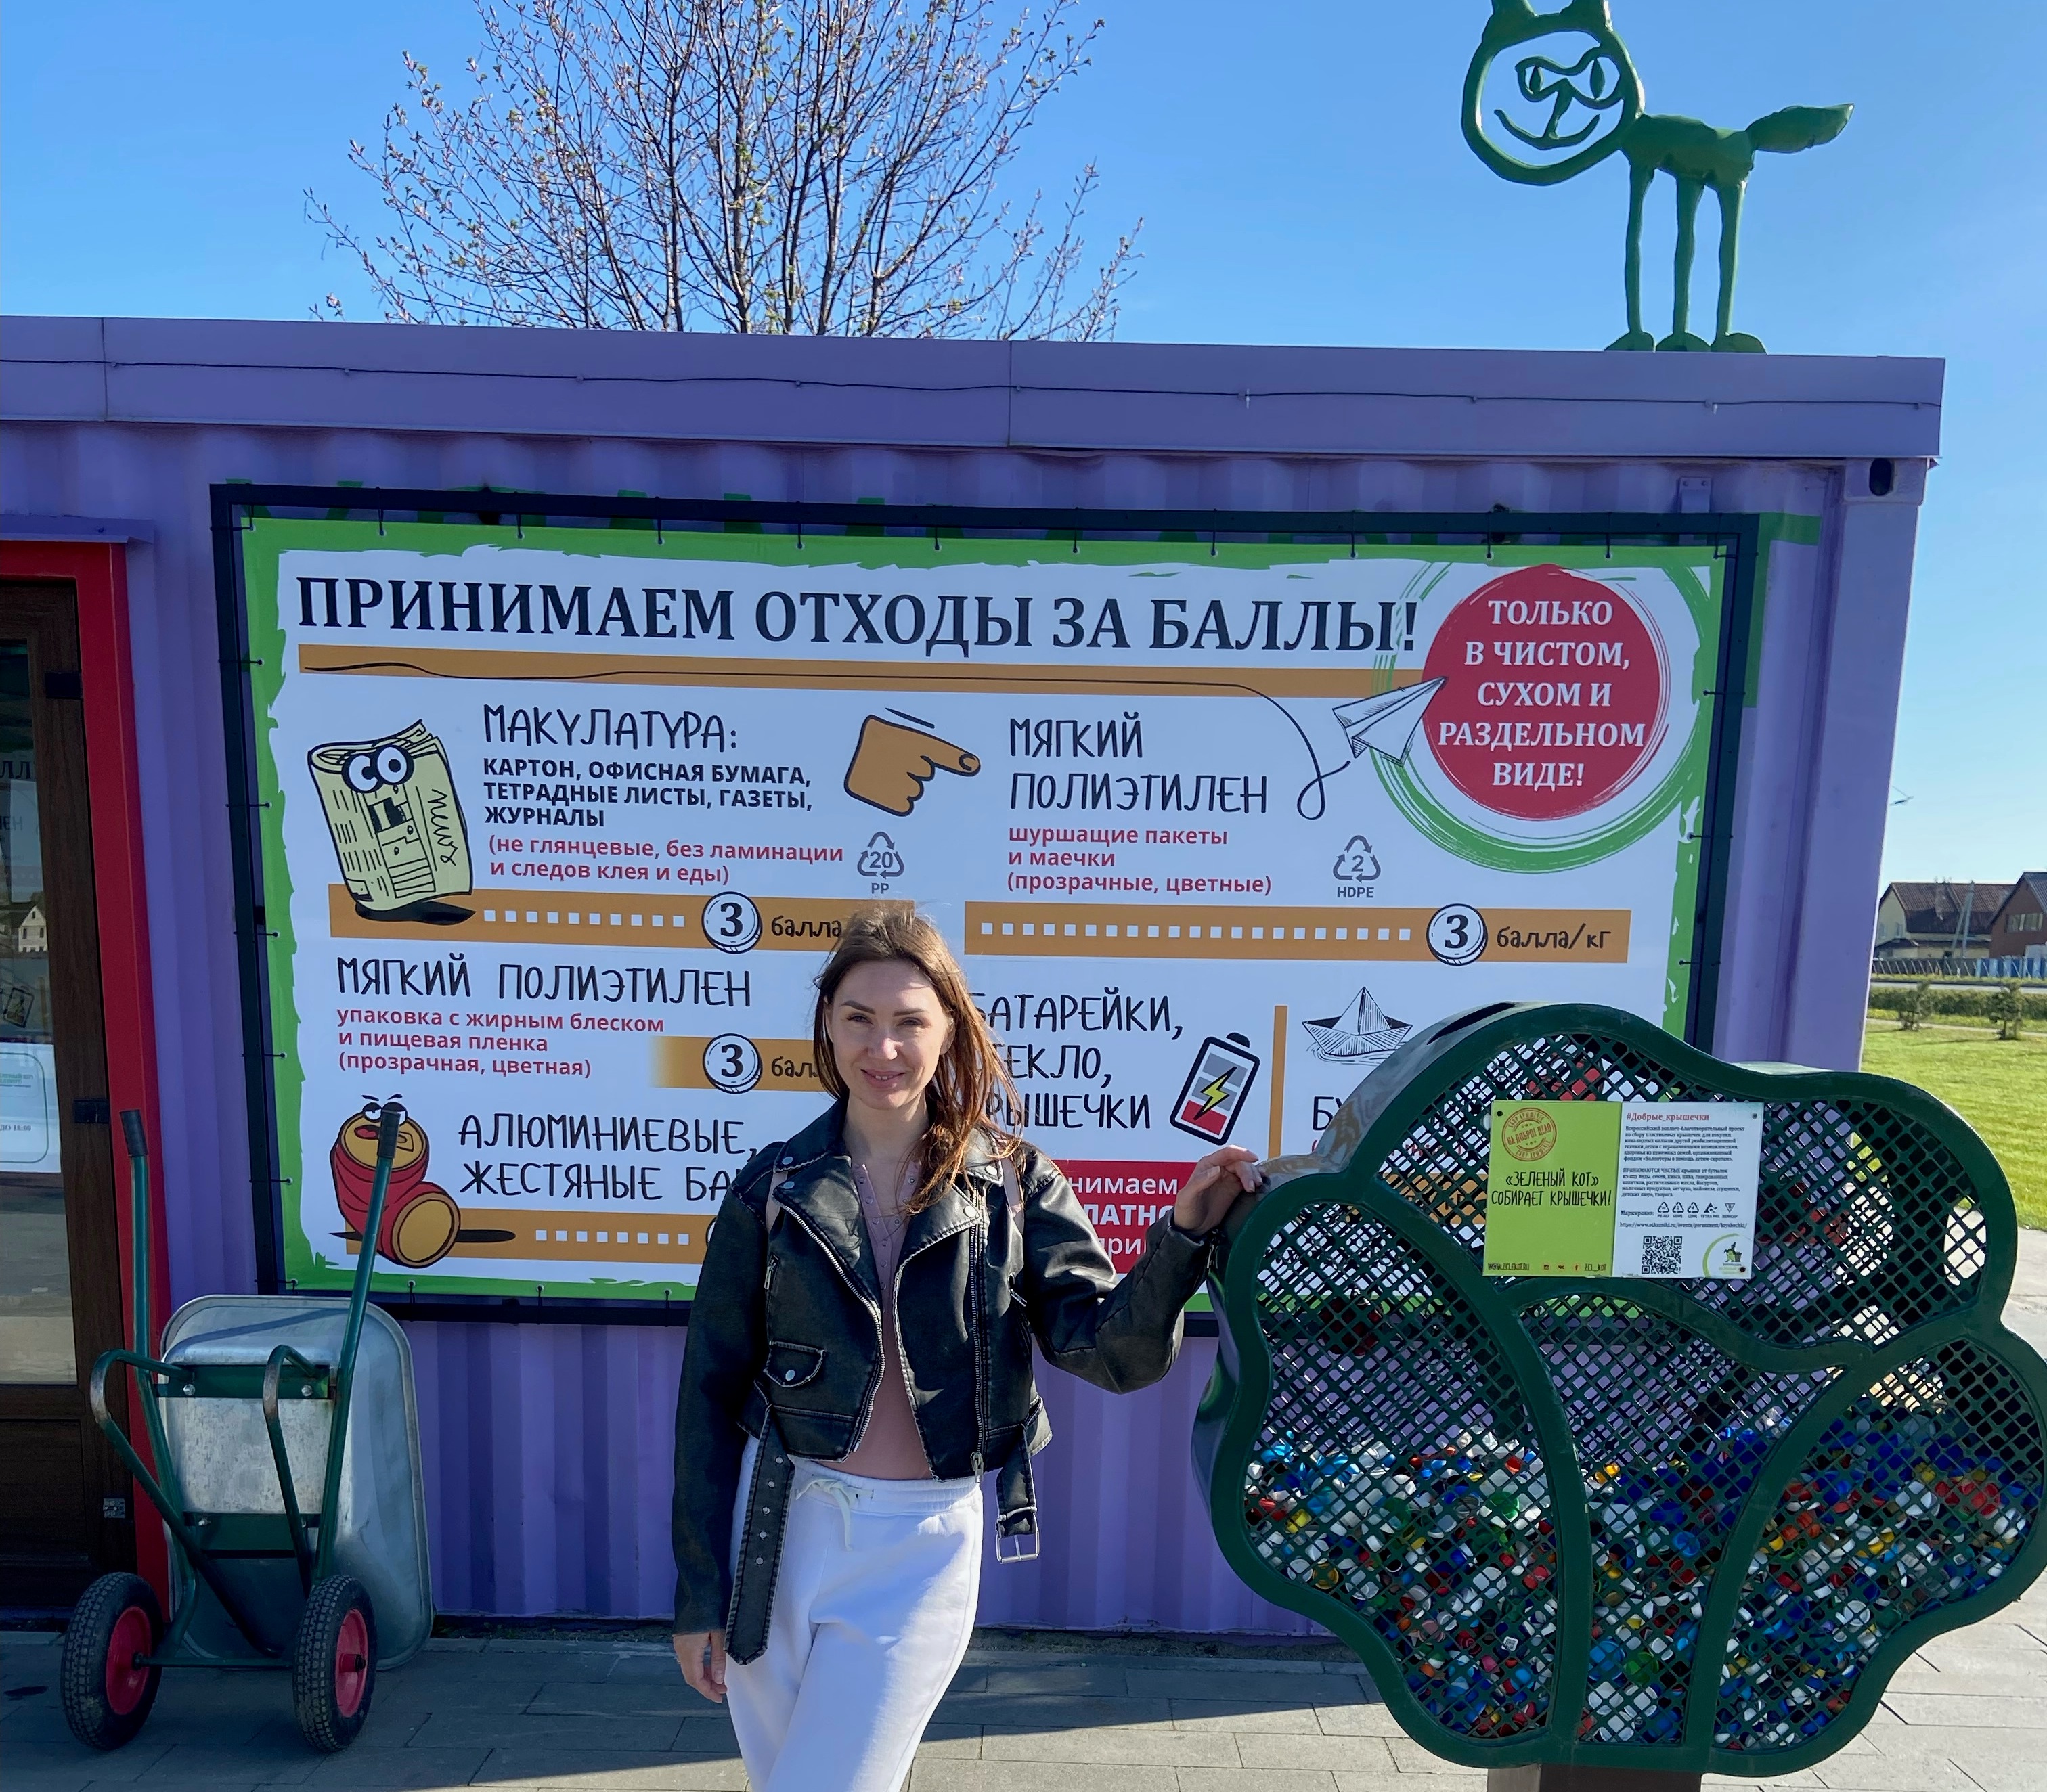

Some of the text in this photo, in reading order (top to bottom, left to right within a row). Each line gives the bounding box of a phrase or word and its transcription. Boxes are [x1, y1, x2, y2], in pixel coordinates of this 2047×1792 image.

[296, 577, 1417, 658] ПРИНИМАЕМ ОТХОДЫ ЗА БАЛЛЫ!
[1489, 601, 1612, 625] ТОЛЬКО
[1464, 642, 1629, 669] В ЧИСТОМ,
[1478, 682, 1612, 706] СУХОМ И
[484, 704, 736, 752] МАКУЛАТУРА:
[1011, 712, 1143, 757] МЯГКИЙ
[1439, 723, 1644, 751] РАЗДЕЛЬНОМ
[484, 758, 810, 787] КАРТОН, ОФИСНАЯ БУМАГА,
[1493, 763, 1583, 791] ВИДЕ!
[484, 782, 812, 811] ТЕТРАДНЫЕ ЛИСТЫ, ГАЗЕТЫ,
[1011, 773, 1267, 813] ПОЛИЭТИЛЕН
[485, 807, 604, 826] ЖУРНАЛЫ
[489, 835, 842, 864] (не глянцевые, без ламинации
[1010, 828, 1227, 847] шуршащие пакеты
[870, 851, 897, 868] 20
[1009, 852, 1114, 866] и маечки
[1352, 855, 1363, 872] 2
[491, 862, 728, 885] и следов клея и еды)
[1008, 872, 1271, 895] (прозрачные, цветные)
[872, 883, 889, 894] PP
[1338, 887, 1374, 897] HDPE
[720, 903, 743, 937] 3
[1445, 915, 1611, 949] 3 балла/кг
[338, 953, 750, 1006] МЯГКИЙ ПОЛИЭТИЛЕН
[337, 1010, 663, 1032] упаковка с жирным блеском
[339, 1033, 547, 1051] и пищевая пленка
[340, 1052, 590, 1078] (прозрачная, цветная)
[722, 1044, 743, 1077] 3
[1627, 1113, 1709, 1121] #Добрые_крышечки
[458, 1113, 761, 1159] АЛЮМИНИЕВЫЕ,
[1515, 1127, 1537, 1144] ДОБРОЕ
[460, 1161, 663, 1200] ЖЕСТЯНЫЕ
[1506, 1167, 1600, 1187] «ЗЕЛЕНЫЙ КОТ»
[1491, 1190, 1545, 1207] СОБИРАЕТ
[1550, 1190, 1612, 1207] КРЫШЕЧКИ!
